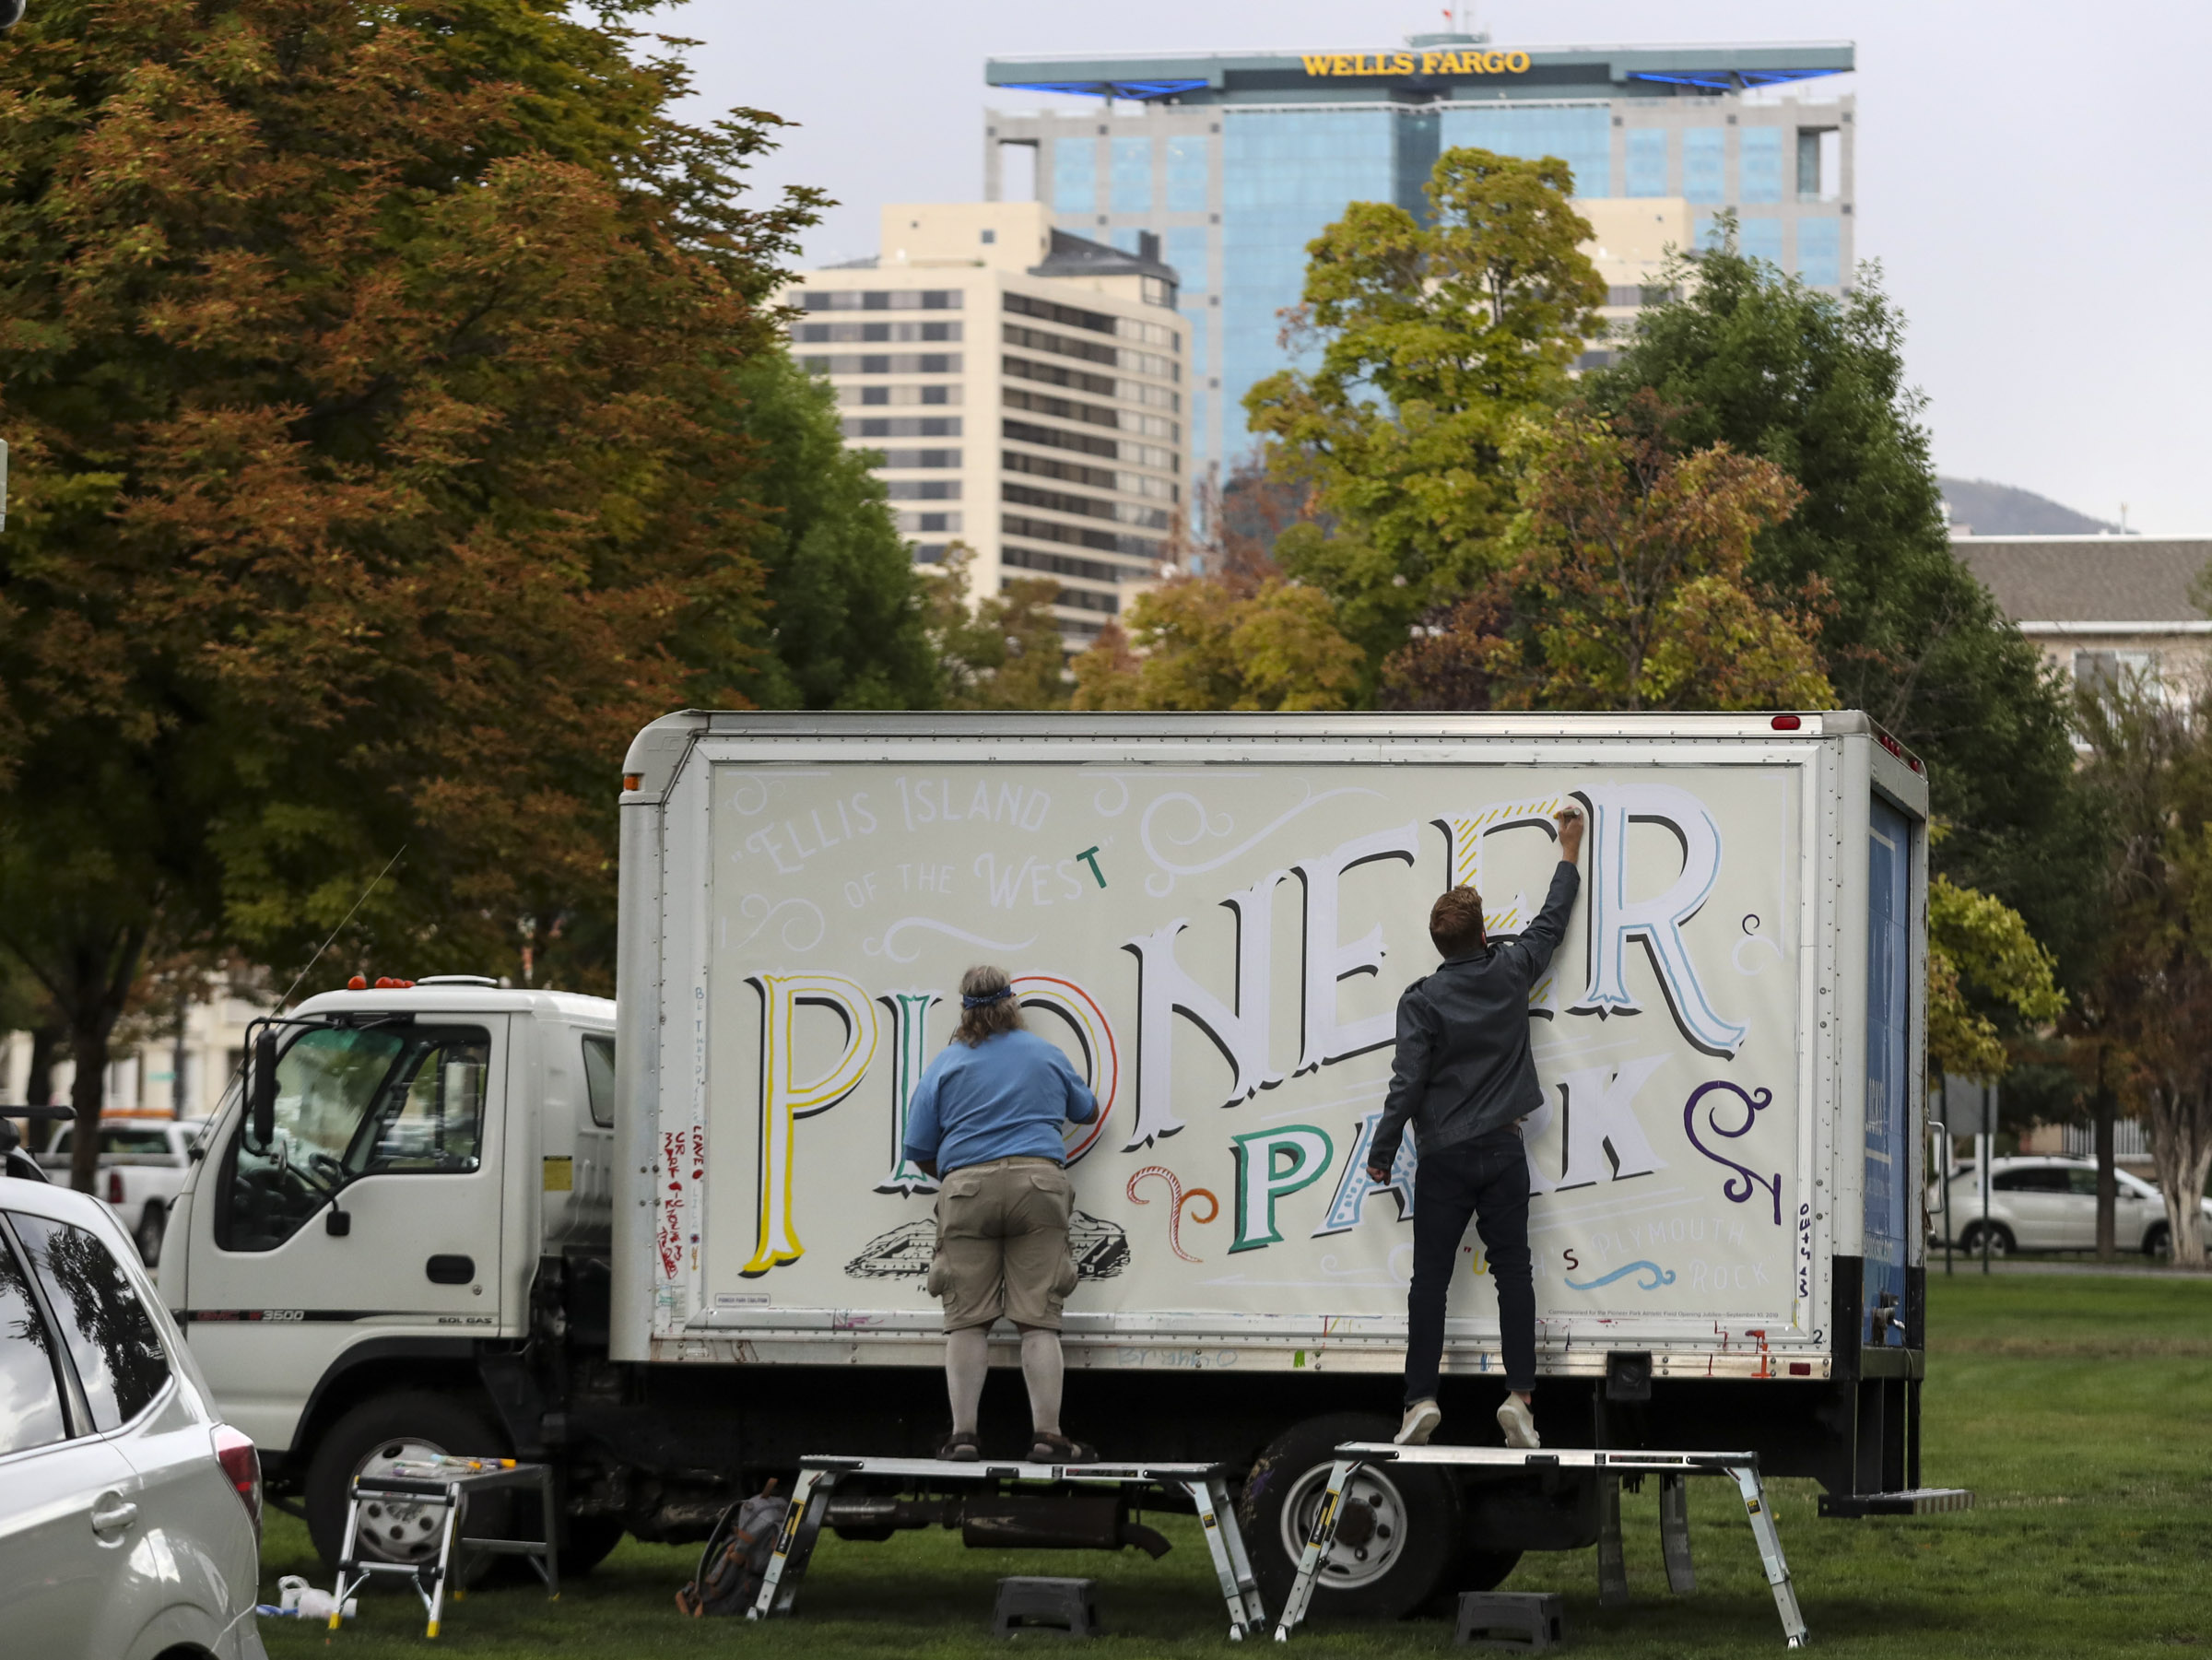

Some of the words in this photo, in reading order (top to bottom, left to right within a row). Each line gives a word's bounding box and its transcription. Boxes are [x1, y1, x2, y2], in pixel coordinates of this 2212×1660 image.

[1300, 52, 1415, 77] WELLS
[1420, 50, 1531, 74] FARGO
[895, 776, 1052, 830] ISLAND
[844, 872, 877, 909] OF
[896, 863, 955, 894] THE
[693, 1125, 704, 1165] LEAVE
[1229, 1054, 1674, 1254] PAK
[1591, 1218, 1747, 1262] PLYMOUTH
[1813, 1329, 1823, 1344] 2
